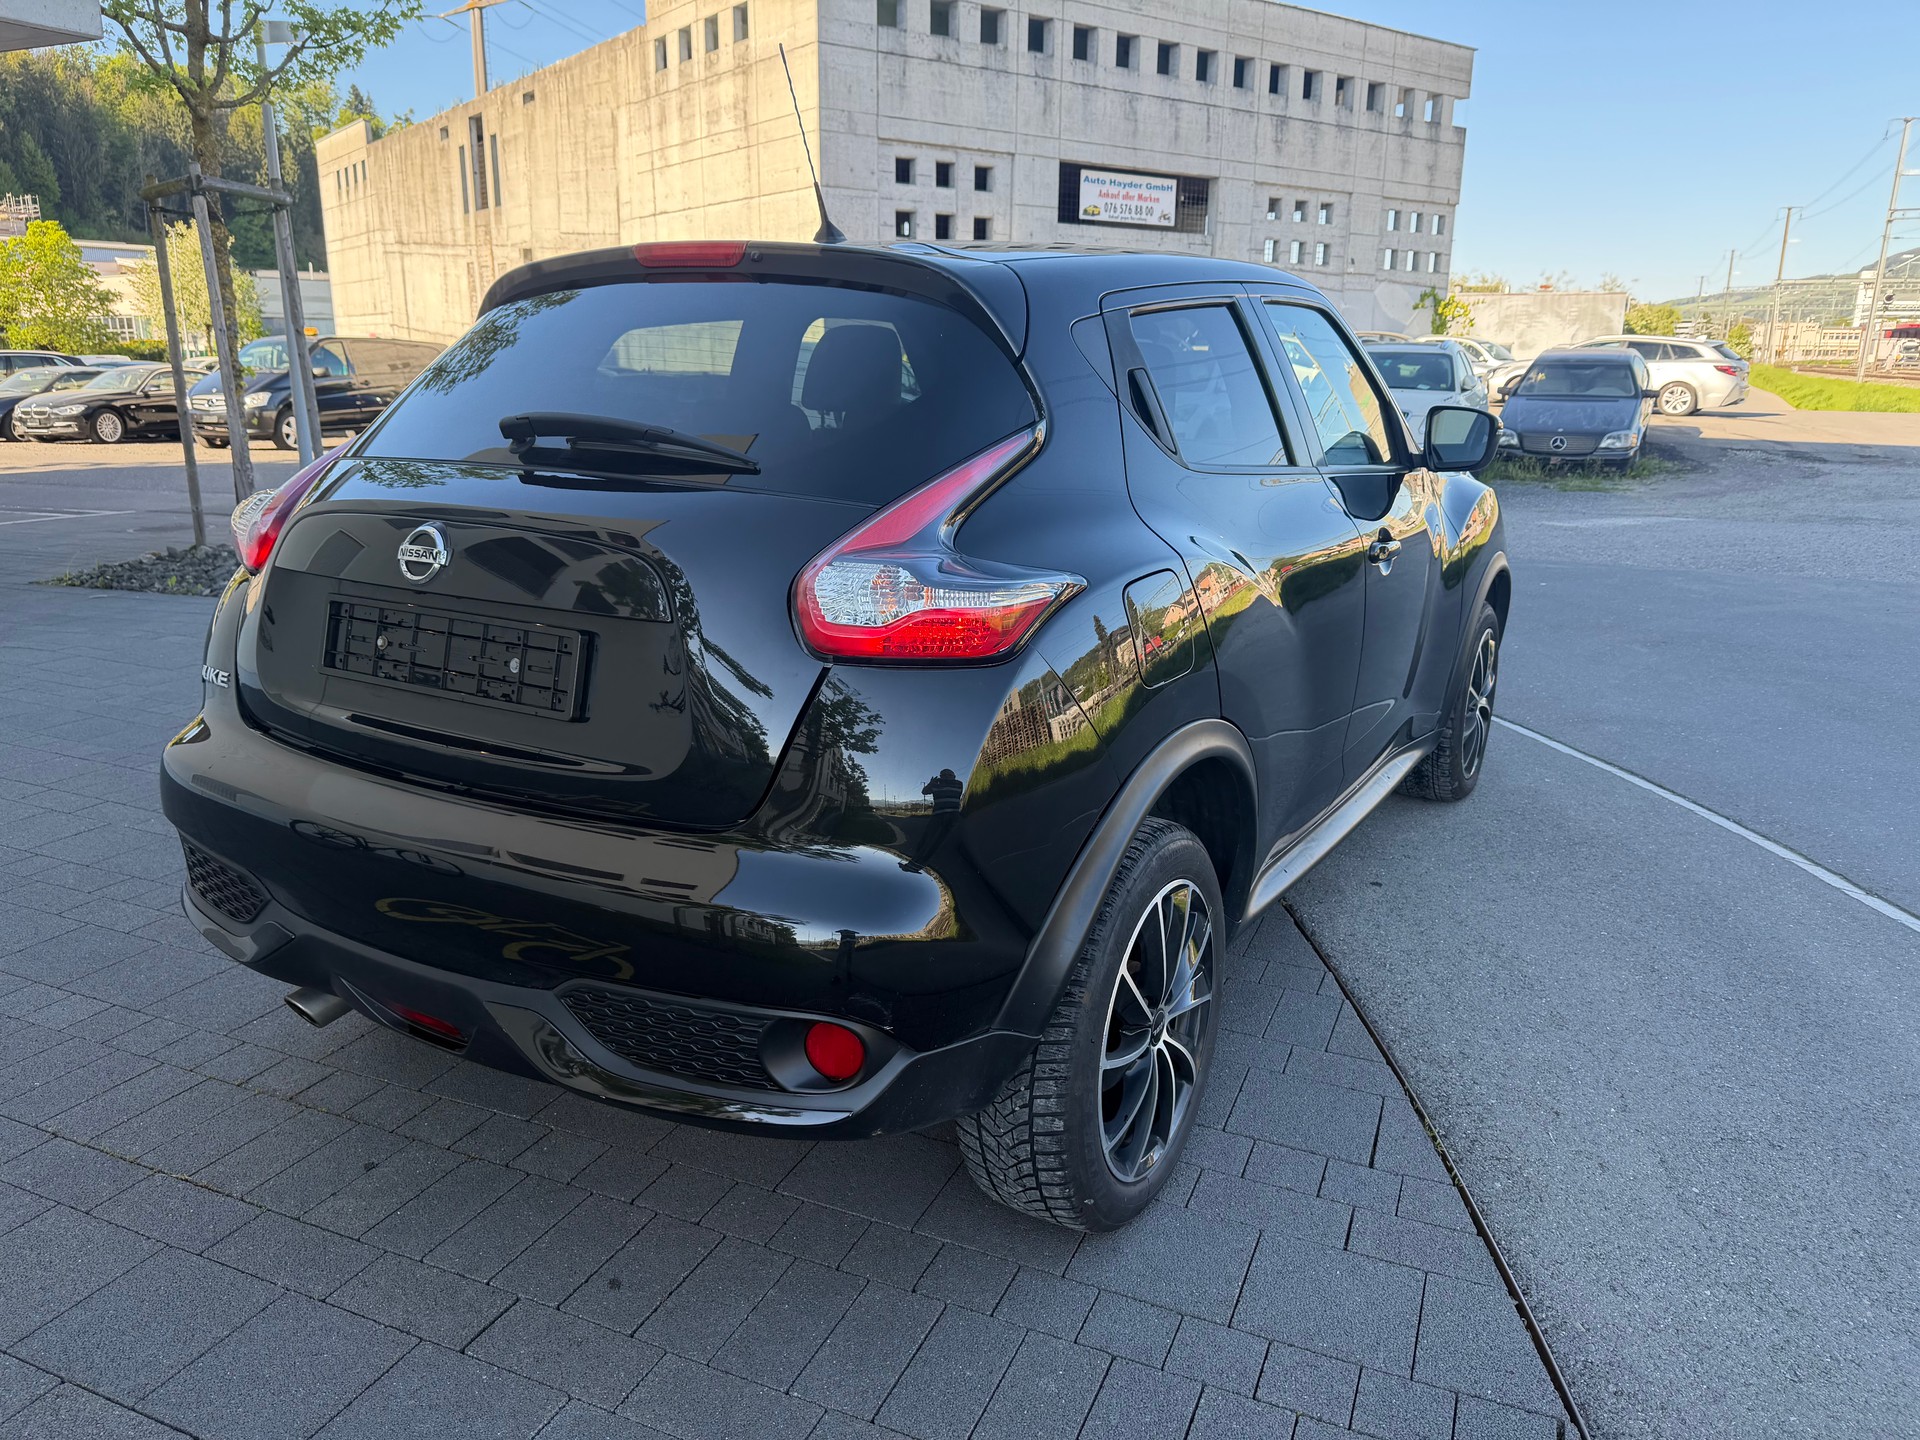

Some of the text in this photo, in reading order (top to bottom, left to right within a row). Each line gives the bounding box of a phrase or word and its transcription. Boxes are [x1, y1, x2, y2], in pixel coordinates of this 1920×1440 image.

[1083, 175, 1173, 192] Auto Hayder GmbH
[1098, 189, 1160, 203] Ankauf aller Marken
[1104, 202, 1154, 217] 076 576 88 00
[399, 547, 438, 561] NISSAN
[202, 664, 230, 688] UKE
